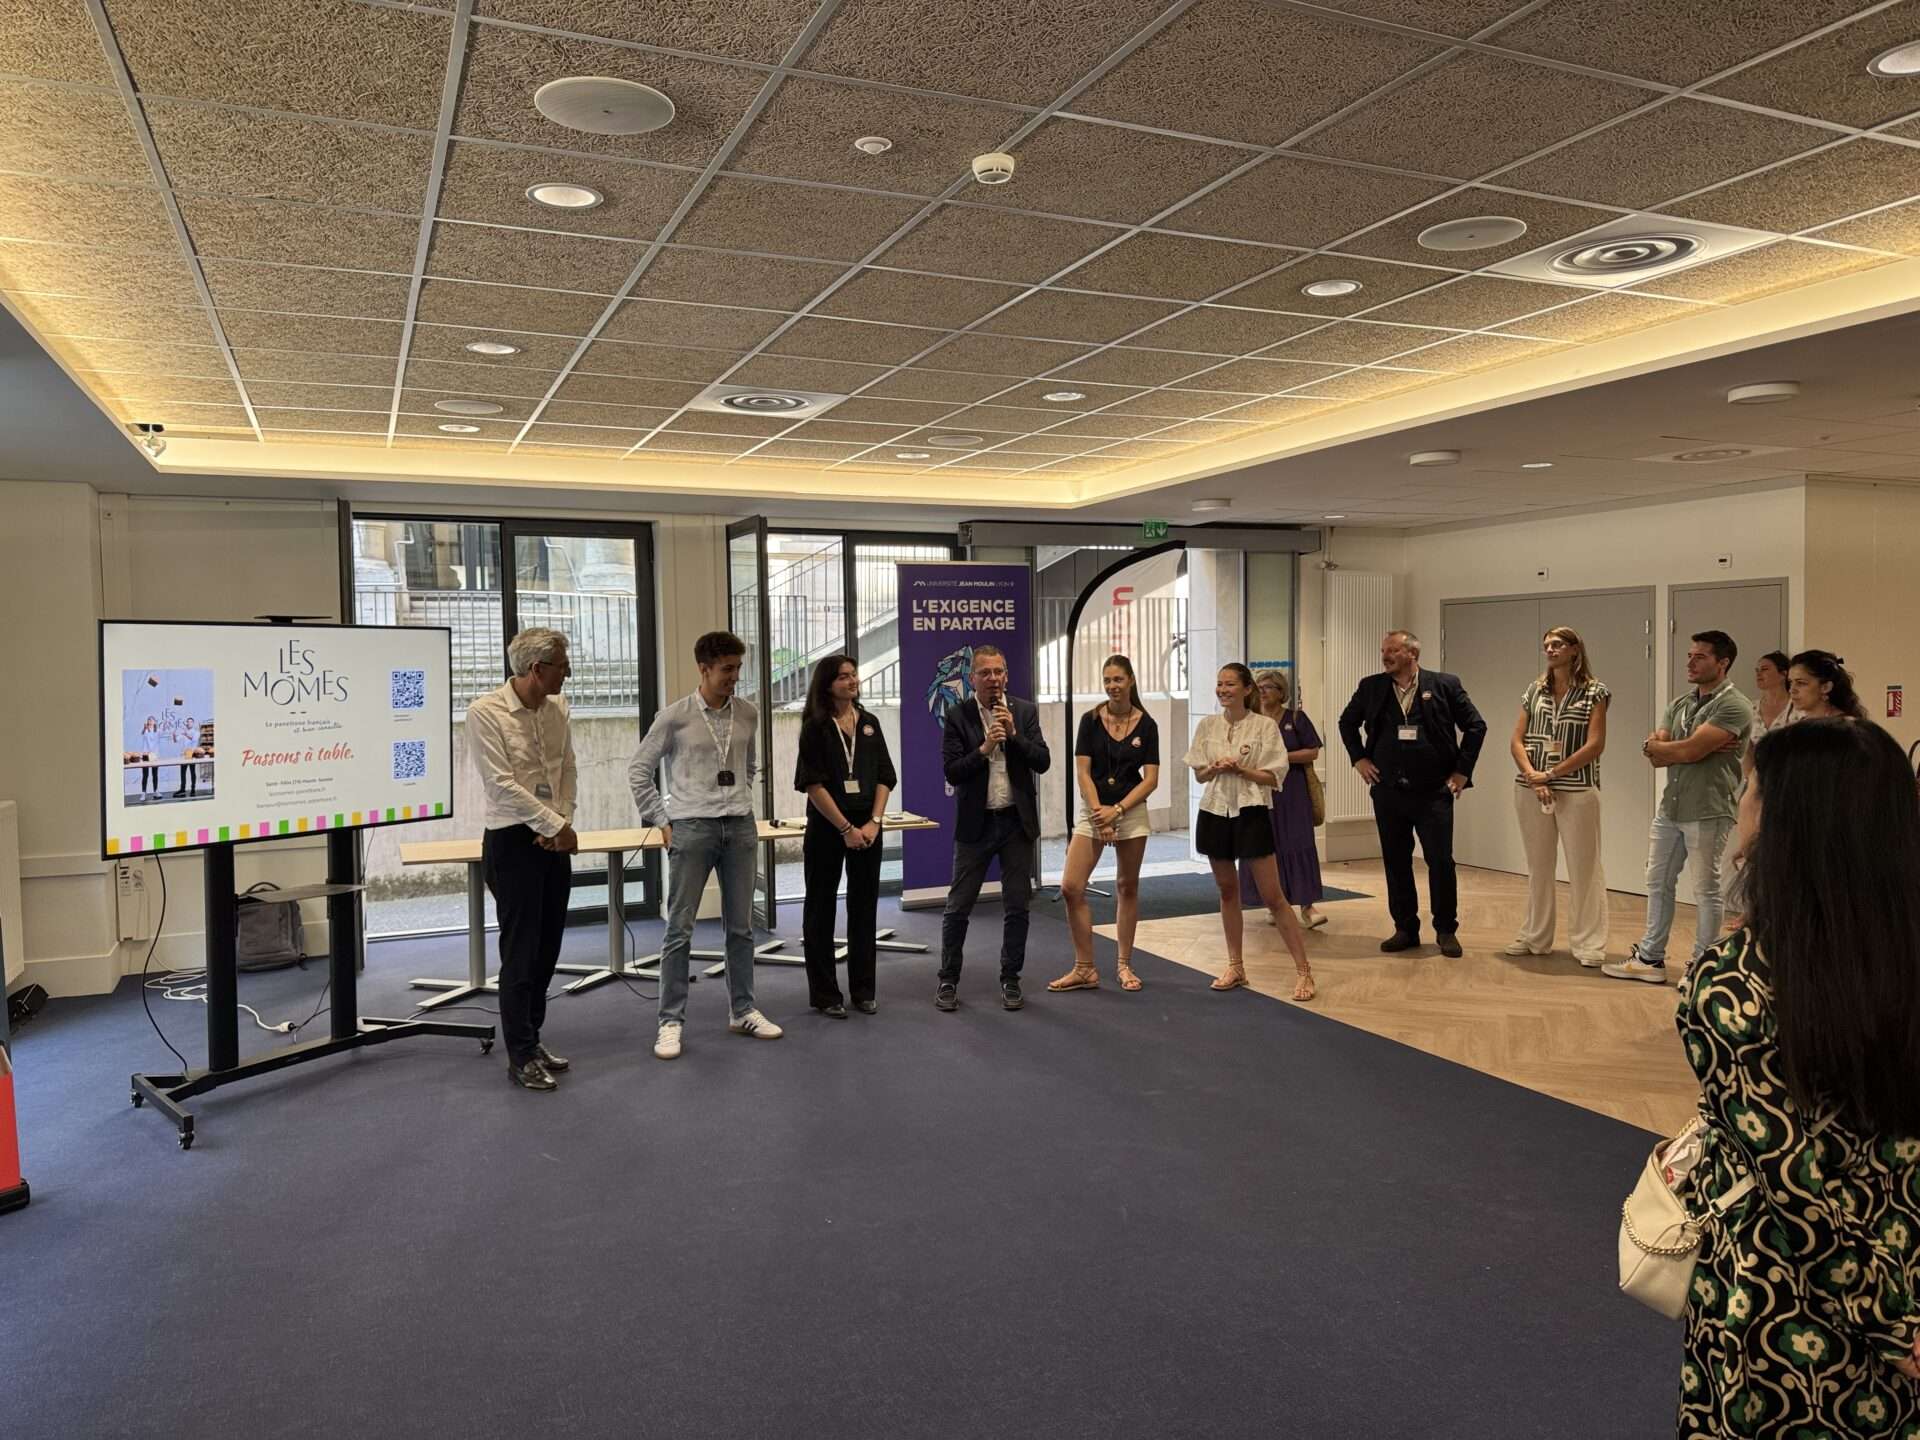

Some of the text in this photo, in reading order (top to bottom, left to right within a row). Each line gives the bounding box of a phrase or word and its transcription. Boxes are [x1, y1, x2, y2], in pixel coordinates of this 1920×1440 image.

[912, 599, 1015, 613] L'EXIGENCE
[913, 617, 1015, 631] EN PARTAGE
[279, 639, 315, 676] LES
[244, 670, 349, 706] MÔMES
[241, 741, 354, 767] Passons à table.
